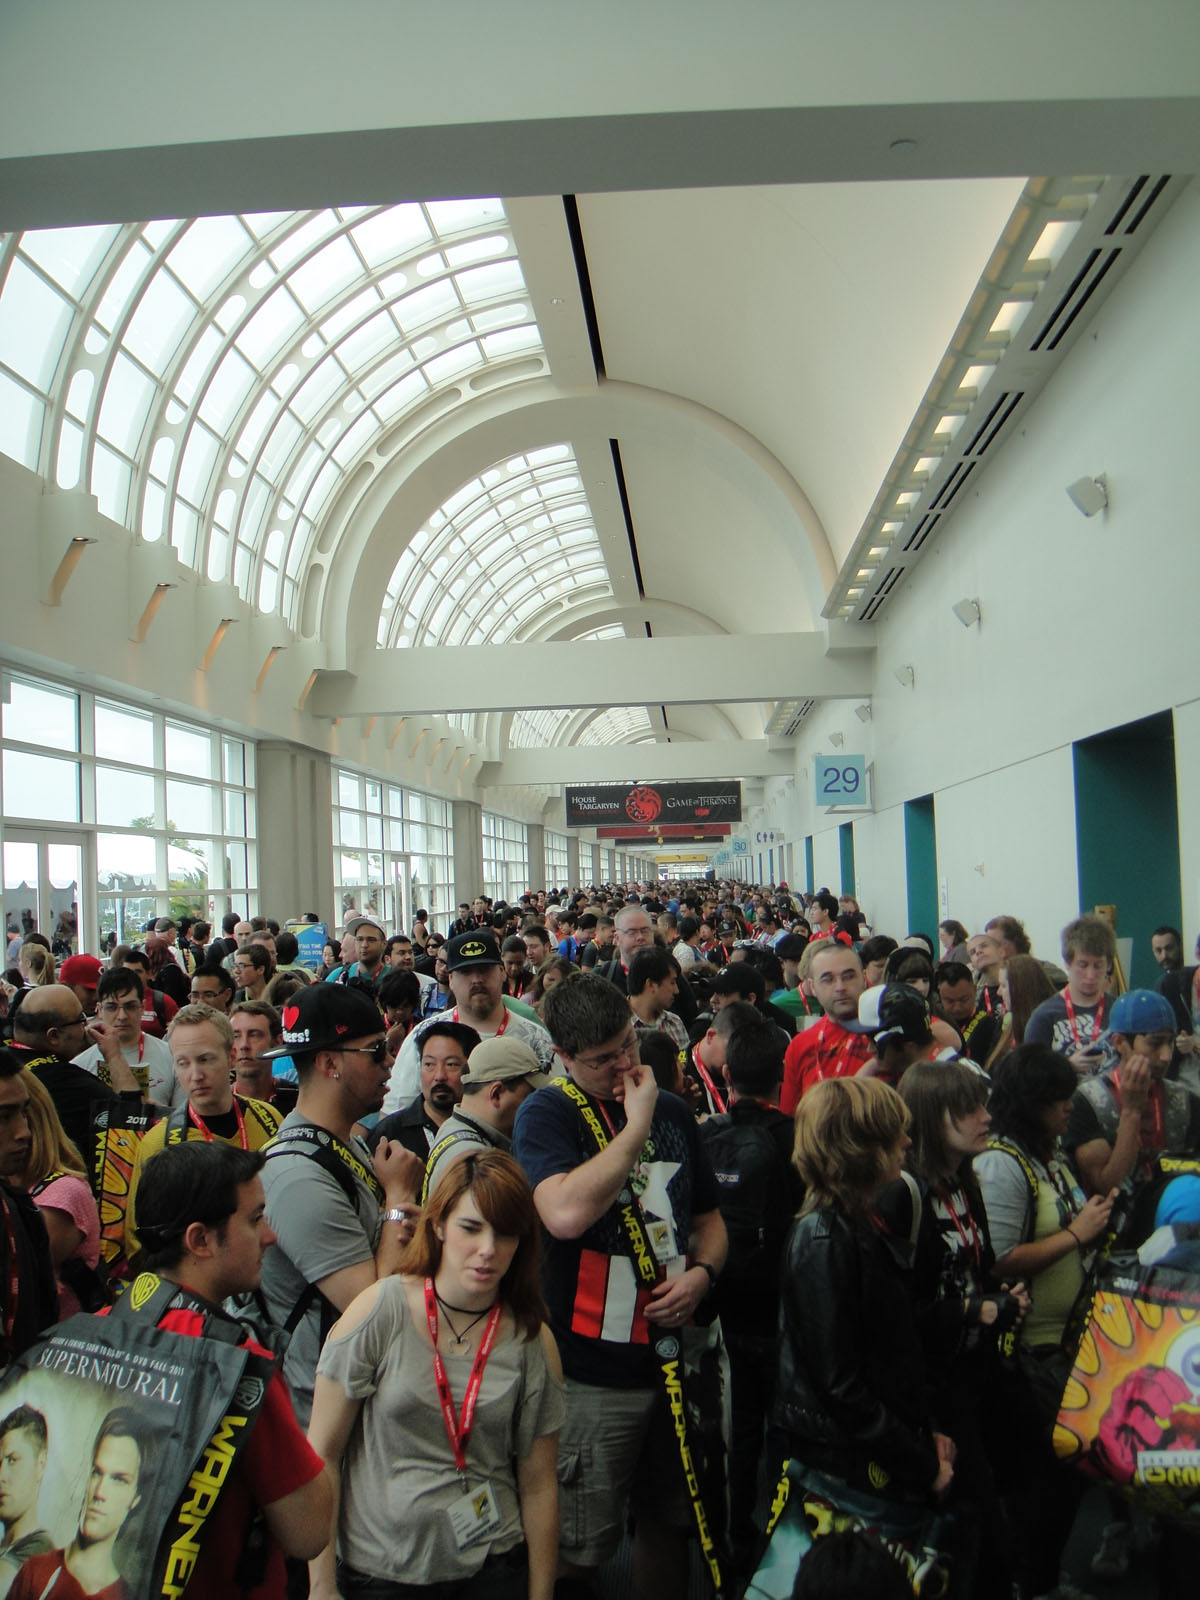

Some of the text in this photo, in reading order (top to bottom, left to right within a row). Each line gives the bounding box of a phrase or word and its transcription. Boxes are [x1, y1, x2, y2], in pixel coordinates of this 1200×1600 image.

[823, 766, 860, 793] 29
[571, 796, 597, 804] HOUSE
[578, 802, 620, 810] TARGARYEN
[666, 797, 693, 808] GAME
[698, 796, 738, 807] THRONES
[734, 841, 747, 851] 30
[550, 1076, 588, 1108] RNER
[125, 1115, 147, 1125] 2011
[332, 1139, 378, 1193] WARNE
[133, 1354, 148, 1366] DVD
[150, 1359, 168, 1372] FALL
[169, 1364, 185, 1376] 2011
[37, 1347, 182, 1406] SUPERNATURAL
